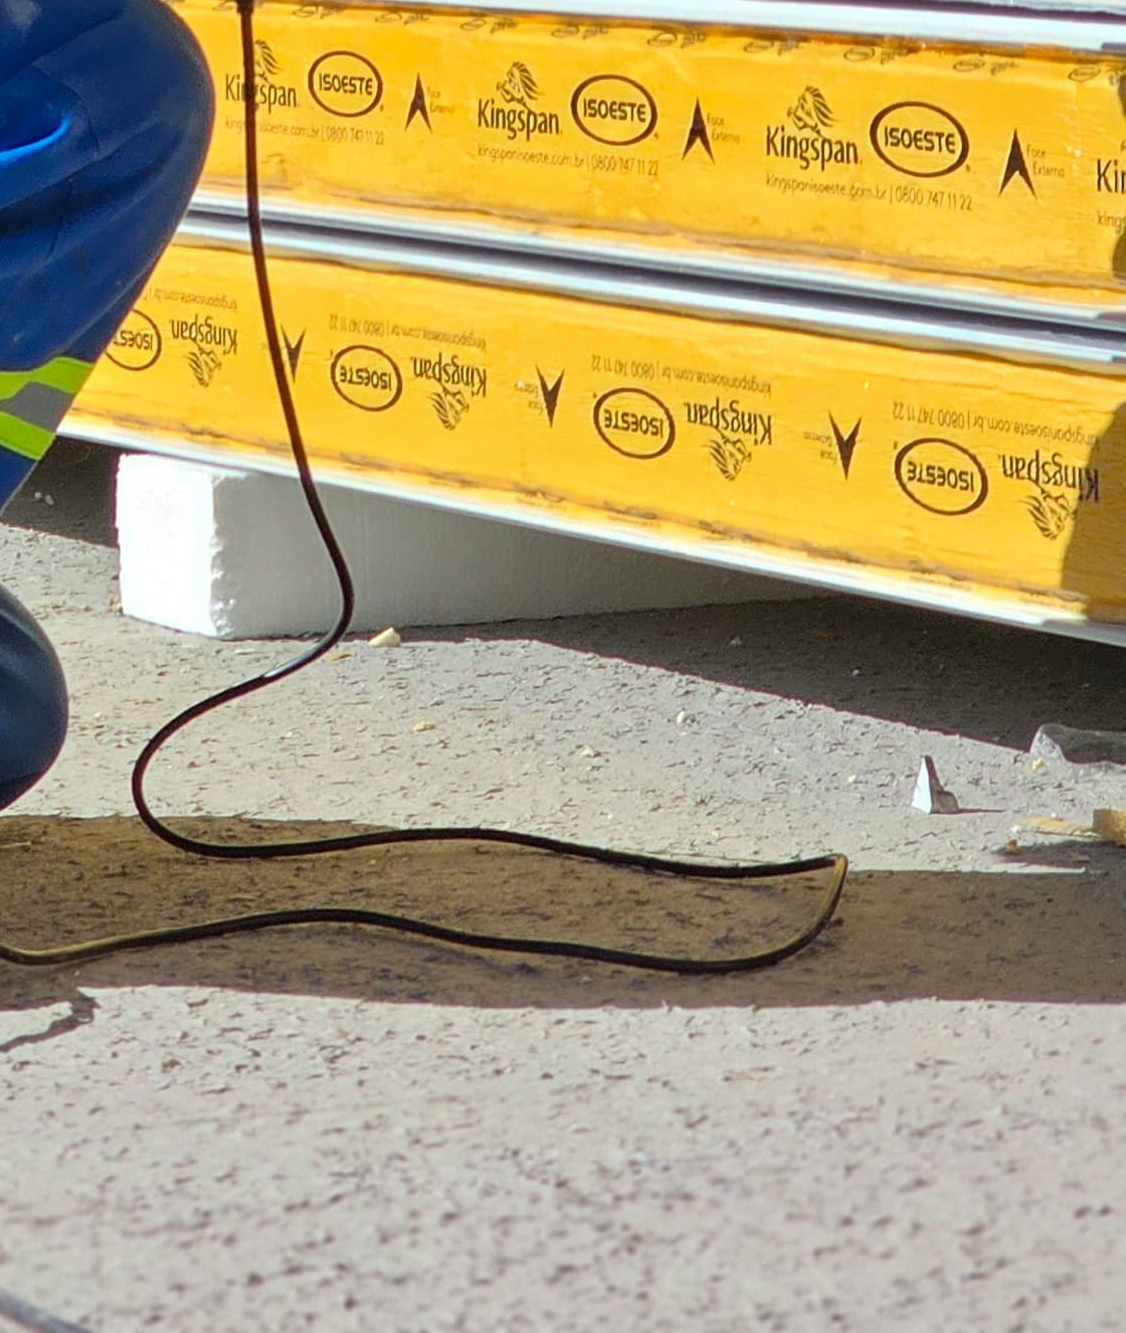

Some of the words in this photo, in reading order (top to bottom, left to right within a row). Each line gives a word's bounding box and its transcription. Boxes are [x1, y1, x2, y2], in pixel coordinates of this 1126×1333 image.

[319, 73, 372, 96] ISOESTE
[478, 98, 560, 141] Kingspan
[584, 98, 646, 123] ISOESTE
[766, 125, 859, 171] Kingspan
[884, 126, 955, 154] ISOESTE
[591, 153, 616, 171] 0800
[622, 156, 635, 172] 747
[895, 190, 923, 205] 0800
[926, 192, 945, 208] 747
[959, 195, 973, 211] 22
[340, 365, 391, 391] ISOESTE
[632, 362, 656, 381] 0800
[604, 409, 664, 438] ISOESTE
[892, 402, 904, 421] 22
[907, 404, 915, 421] 11
[918, 407, 934, 424] 747
[938, 409, 965, 430] 0800
[907, 461, 974, 492] ISOESTE
[1002, 449, 1099, 503] Kingspan
